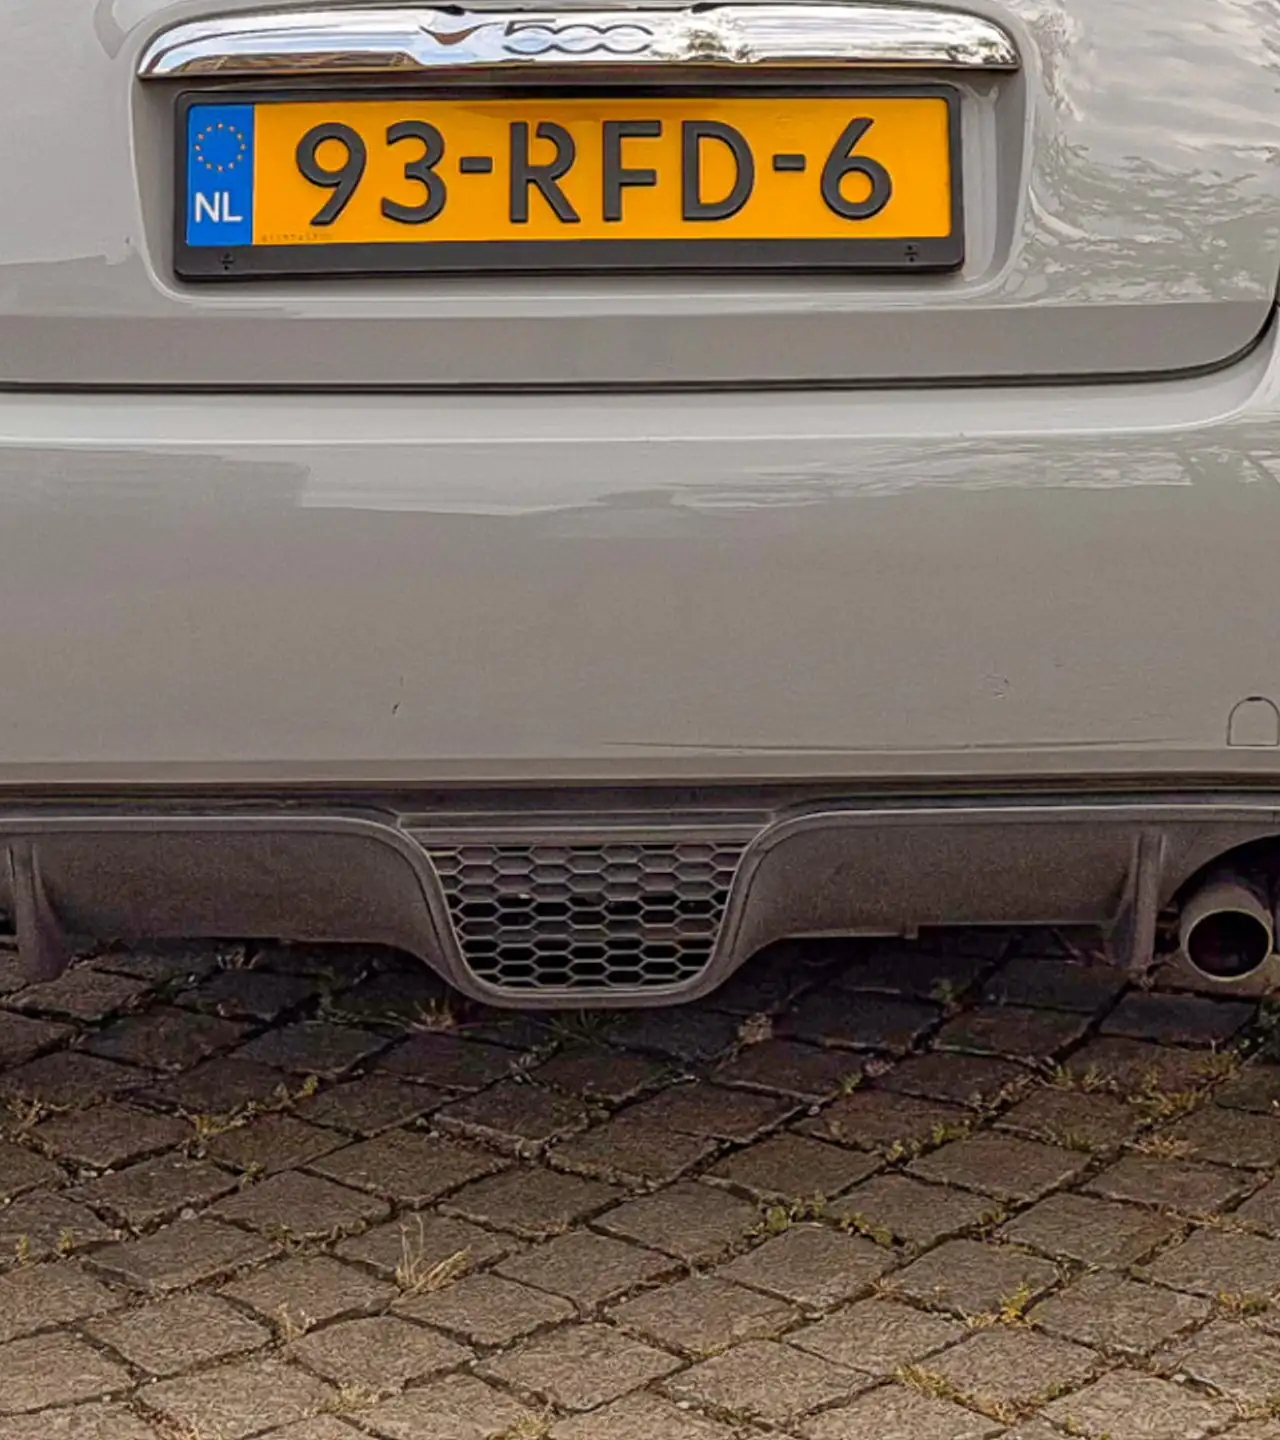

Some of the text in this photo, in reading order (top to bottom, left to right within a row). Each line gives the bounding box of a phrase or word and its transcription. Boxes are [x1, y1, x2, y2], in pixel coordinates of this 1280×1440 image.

[502, 18, 654, 55] 500
[295, 117, 892, 226] 93-RFD-6
[194, 191, 244, 224] NL
